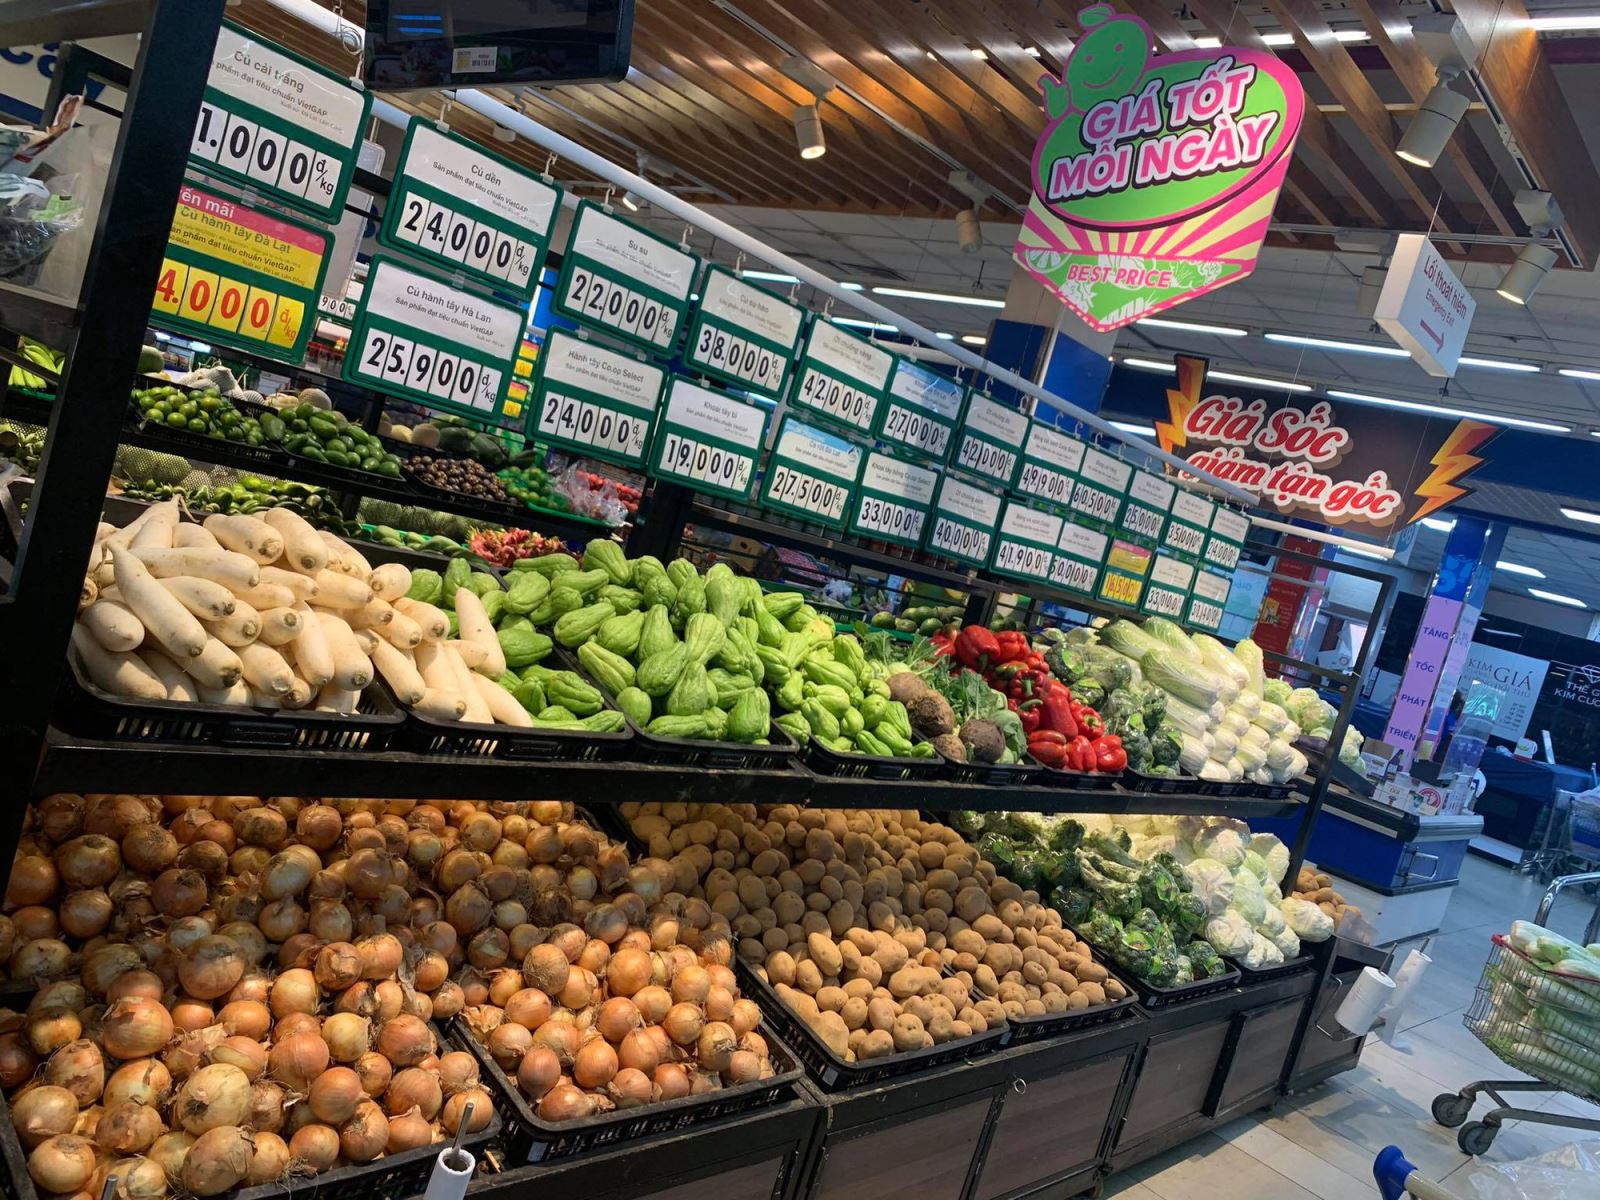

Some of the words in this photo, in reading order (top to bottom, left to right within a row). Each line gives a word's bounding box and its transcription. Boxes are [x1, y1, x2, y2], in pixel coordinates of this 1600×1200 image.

[234, 50, 250, 66] Củ
[254, 58, 272, 78] cải
[274, 70, 304, 94] trắng
[297, 98, 328, 117] VietGAP
[1084, 80, 1162, 142] GIÁ
[1170, 58, 1255, 127] TỐT
[1050, 137, 1131, 198] MỖI
[1136, 113, 1274, 184] NGÀY
[471, 164, 484, 178] Củ
[485, 170, 501, 187] dền
[205, 198, 234, 219] mãi
[202, 211, 230, 232] hành
[234, 223, 252, 242] tây
[254, 232, 270, 246] Đà
[273, 240, 292, 254] Lạt
[404, 201, 512, 268] 24.000
[628, 240, 639, 252] Su
[640, 245, 649, 256] su
[264, 256, 295, 274] VietGAP
[1067, 264, 1110, 282] BEST
[1114, 268, 1172, 288] PRICE
[406, 284, 420, 296] Củ
[422, 290, 444, 306] hành
[446, 297, 462, 314] tây
[462, 302, 474, 316] Hà
[476, 309, 492, 324] Lan
[572, 274, 656, 330] 22.000
[367, 337, 474, 394] 25.900
[568, 350, 588, 363] Hành
[622, 368, 644, 383] Select
[700, 330, 769, 378] 38.000
[804, 374, 863, 417] 42.000
[544, 398, 630, 444] 24.000
[888, 410, 940, 446] 27.000
[1185, 396, 1265, 444] Giá
[1256, 403, 1348, 461] Sốc
[667, 440, 734, 479] 19.000
[963, 440, 1006, 471] 42.000
[773, 472, 832, 508] 27.500
[1022, 468, 1064, 496] 49.900
[1074, 486, 1112, 514] 60.500
[1267, 463, 1328, 504] tận
[1326, 473, 1397, 516] gốc
[862, 501, 912, 532] 33.000
[936, 522, 980, 549] 40.000
[1000, 545, 1042, 570] 41.900
[1494, 666, 1534, 691] GIÁ
[1554, 688, 1576, 700] KIM
